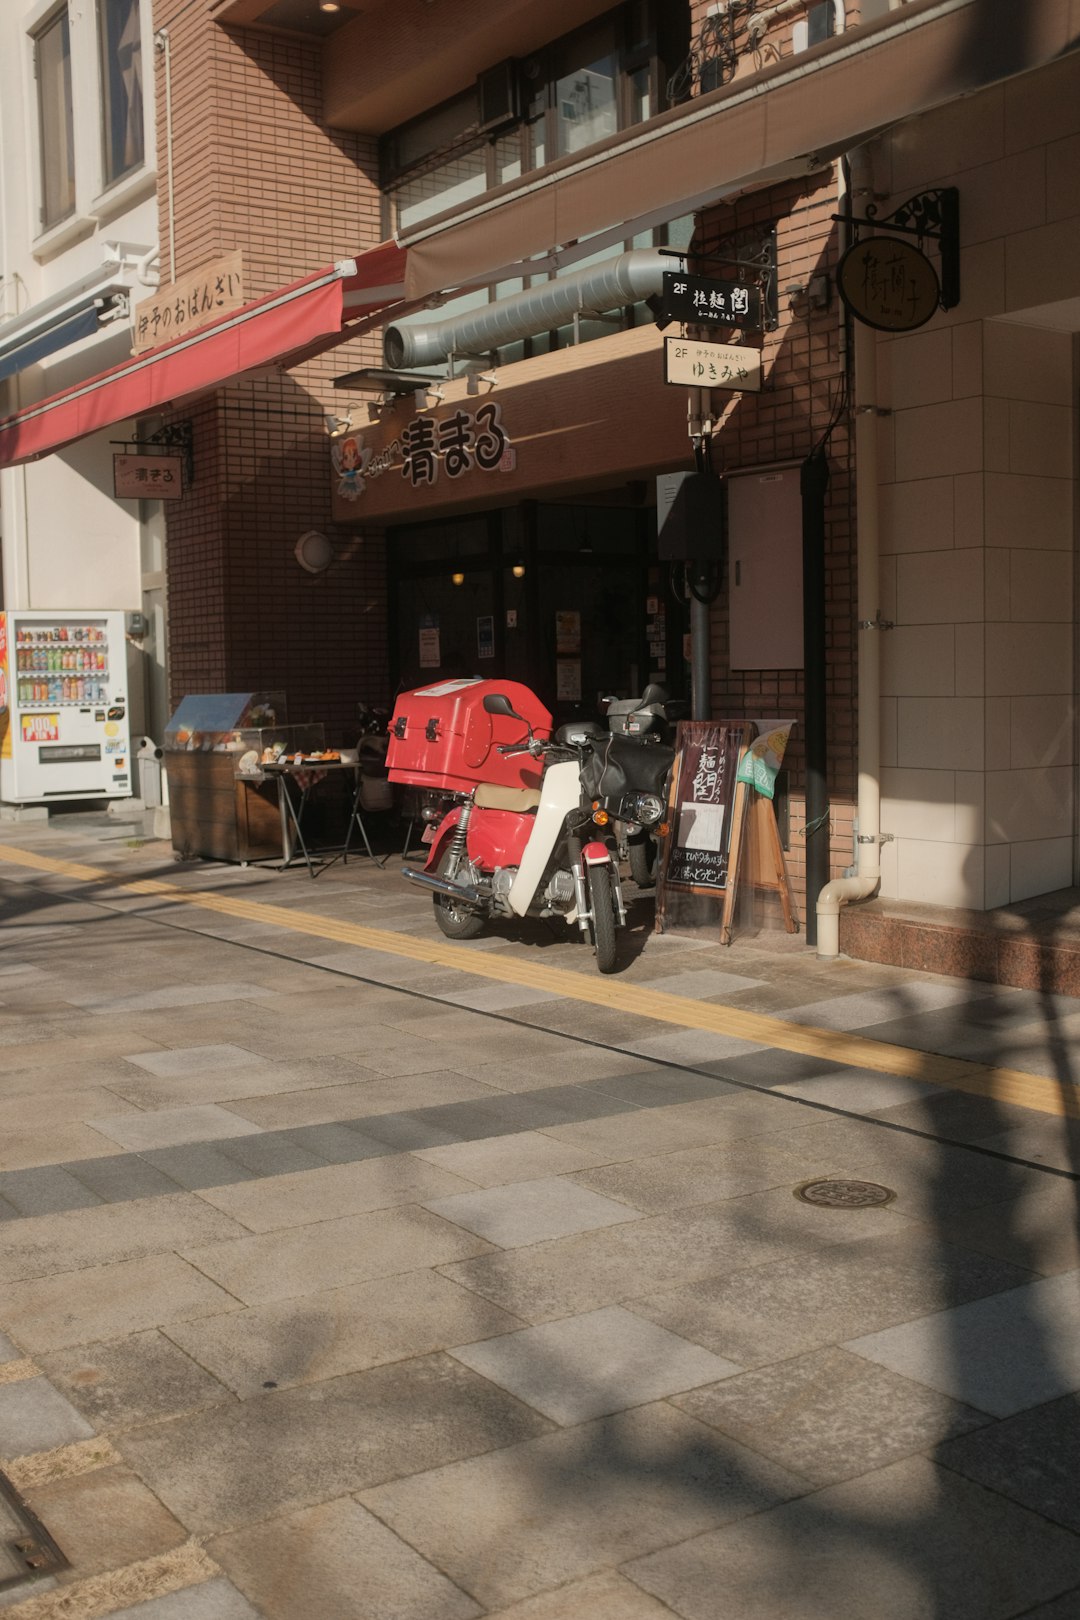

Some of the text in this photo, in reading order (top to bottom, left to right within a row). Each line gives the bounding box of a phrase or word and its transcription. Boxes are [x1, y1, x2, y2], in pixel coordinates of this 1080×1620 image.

[673, 282, 688, 295] 2F
[138, 272, 240, 343] 伊予のおばんざい
[675, 347, 688, 358] 2F
[692, 362, 749, 382] ゆきみや
[401, 402, 506, 486] 清まる
